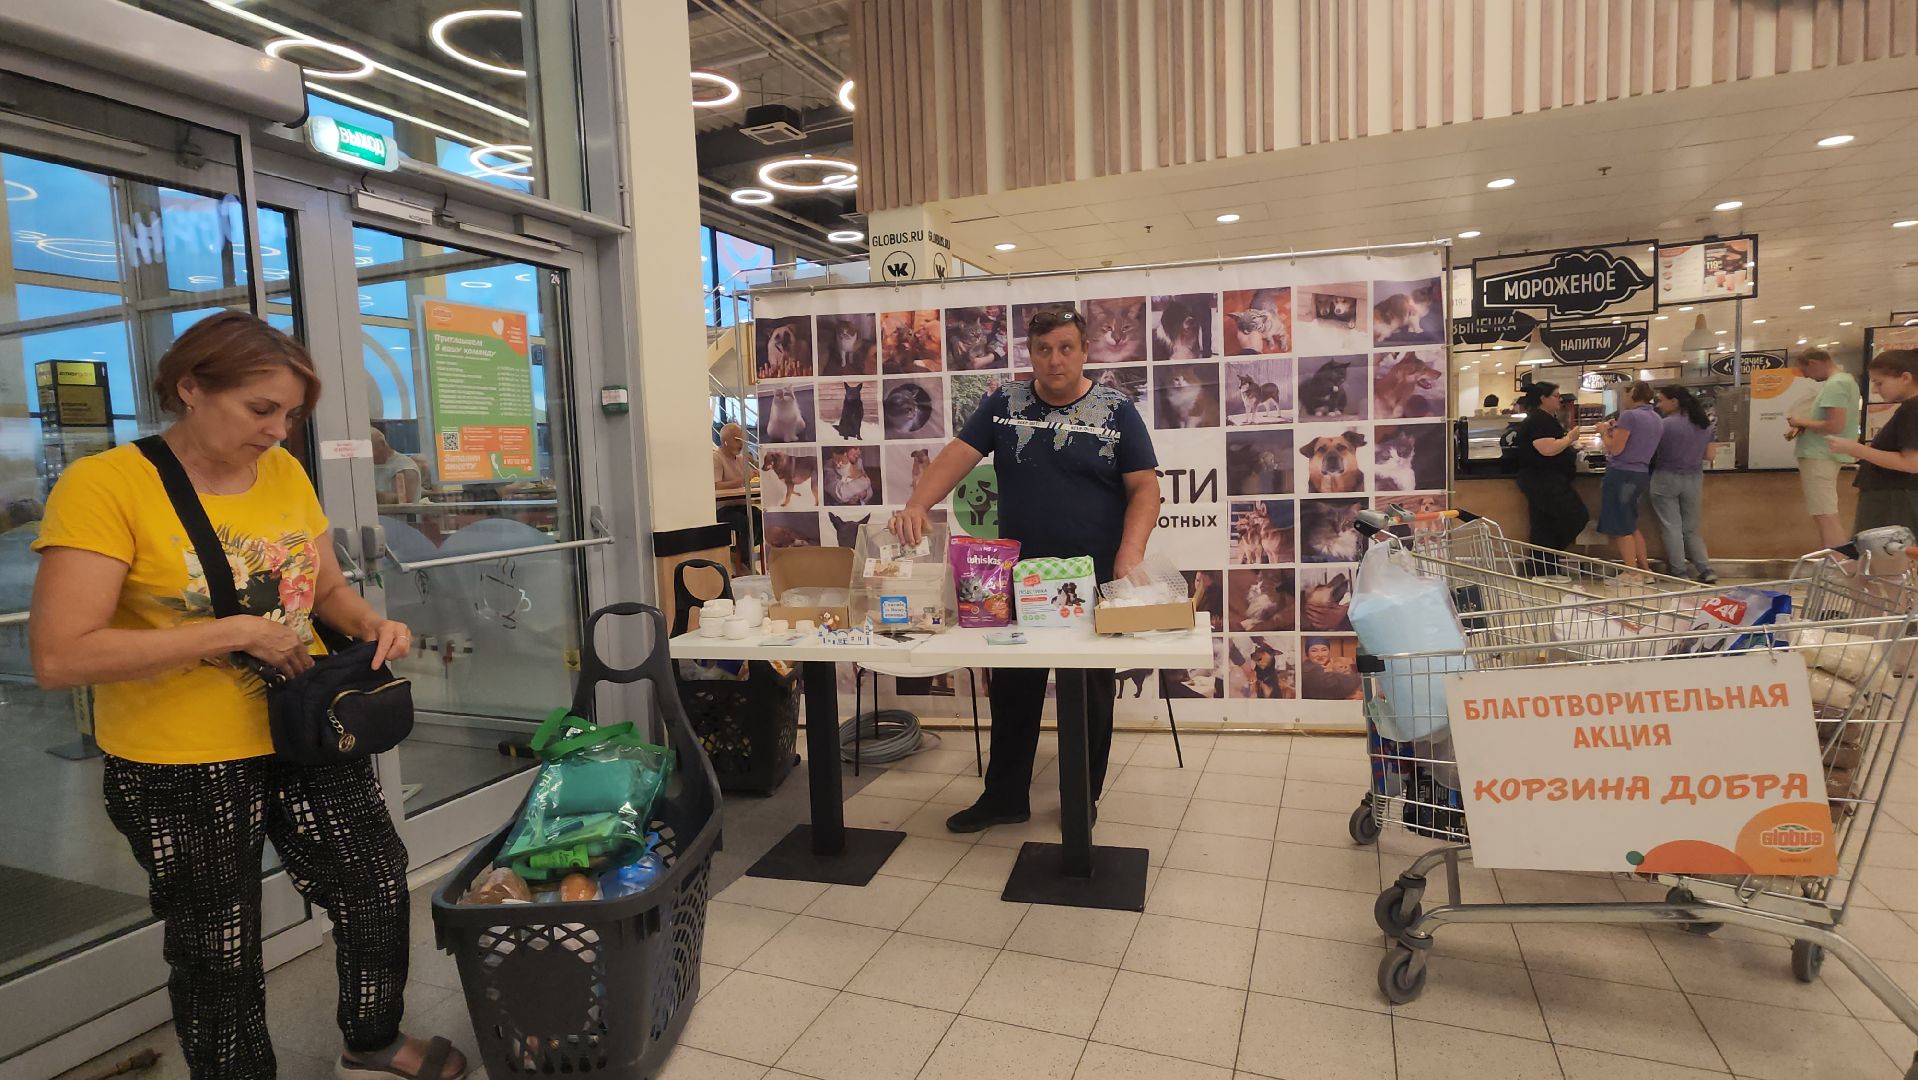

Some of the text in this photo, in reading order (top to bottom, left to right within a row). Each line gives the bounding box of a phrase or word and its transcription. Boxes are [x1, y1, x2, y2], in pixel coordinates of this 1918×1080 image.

[338, 126, 385, 157] ВЫХОД
[872, 229, 924, 247] GLOBUS.RU
[927, 230, 951, 250] GLOBUS.RU
[550, 273, 561, 285] 24
[1503, 270, 1617, 301] МОРОЖЕНОЕ
[463, 347, 497, 358] команду
[1560, 336, 1612, 351] НАПИТКИ
[1464, 683, 1789, 721] БЛАГОТВОРИТЕЛЬНАЯ
[1573, 723, 1672, 750] АКЦИЯ
[1473, 775, 1650, 804] КОРЗИНА
[1660, 773, 1809, 805] ДОБРА
